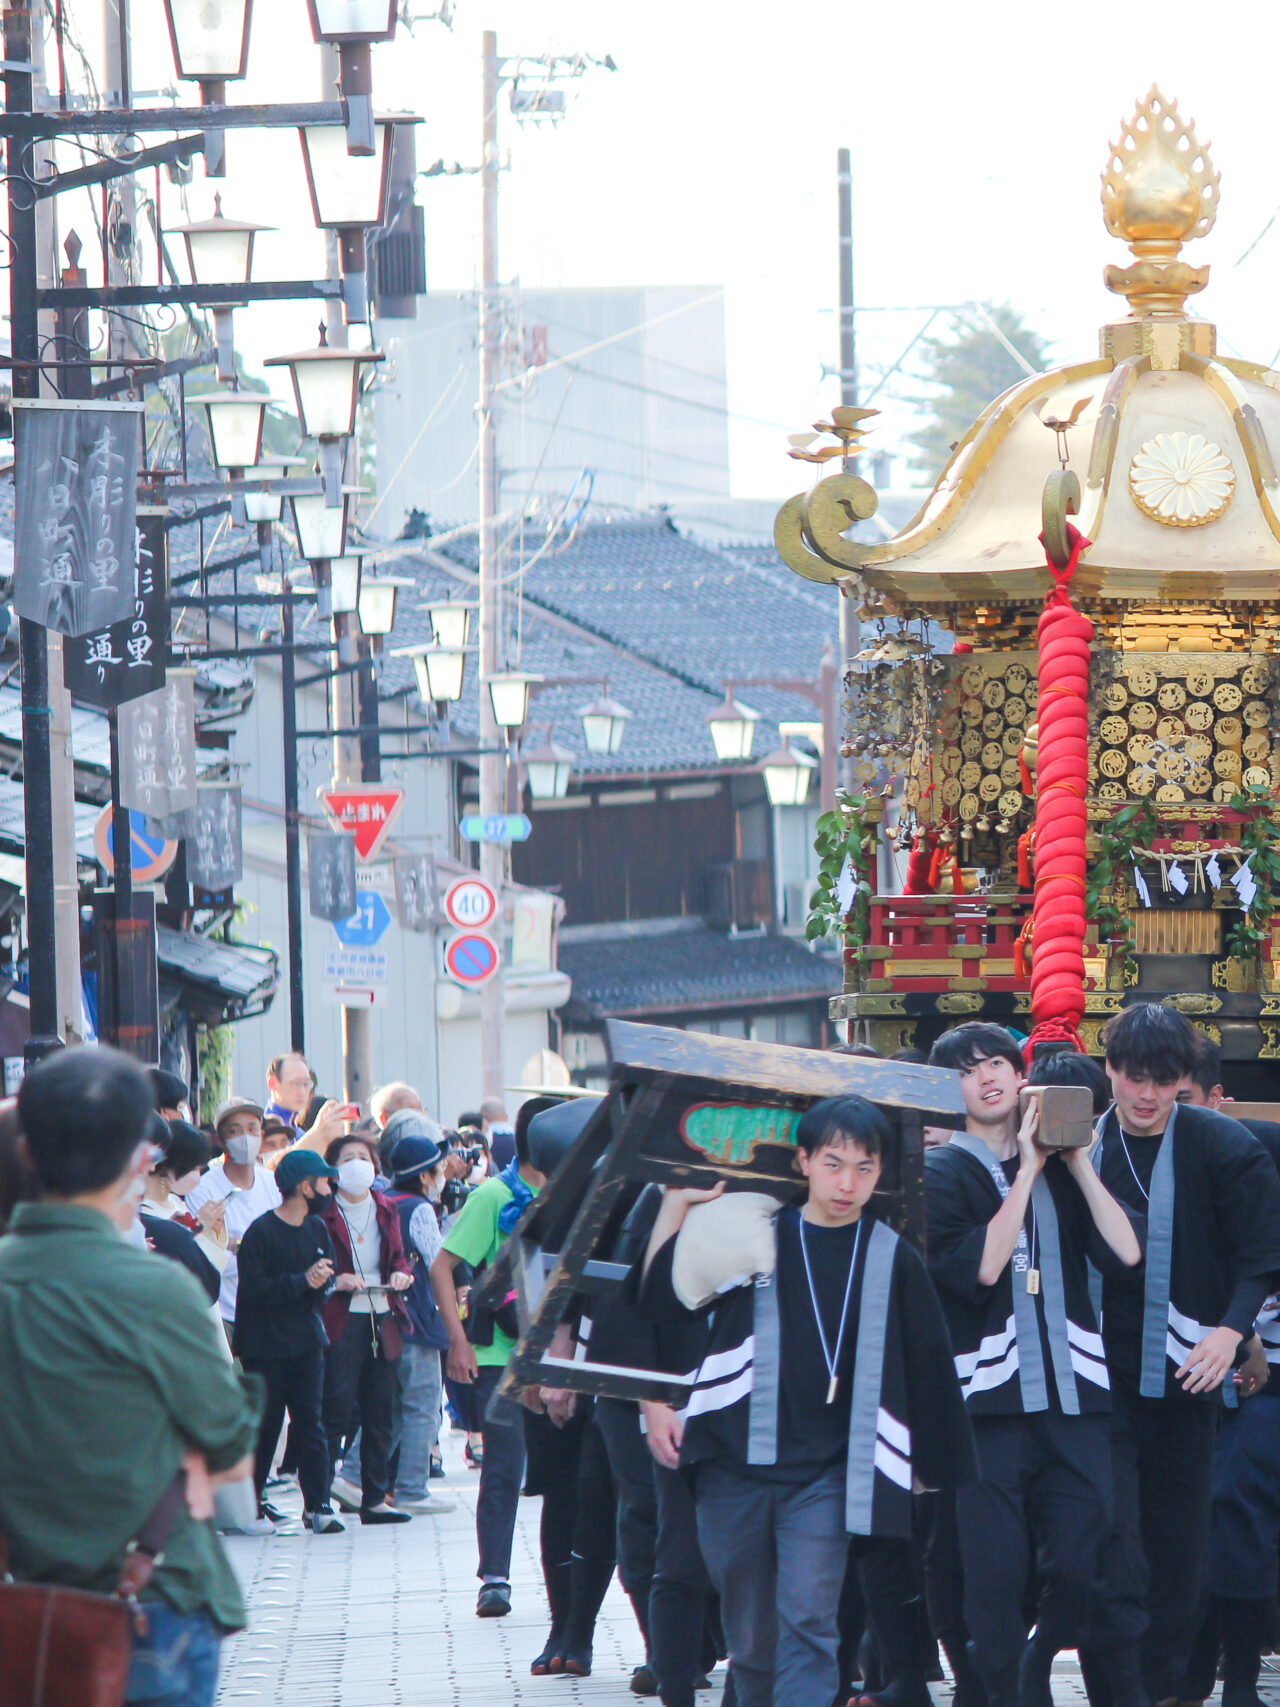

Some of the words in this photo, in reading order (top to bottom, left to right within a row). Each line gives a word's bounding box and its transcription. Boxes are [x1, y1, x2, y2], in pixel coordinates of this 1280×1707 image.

[88, 425, 125, 592] 木彫りの里
[84, 625, 123, 684] 通り
[341, 802, 387, 822] 止まれ
[345, 906, 375, 931] 21
[458, 894, 485, 918] 40
